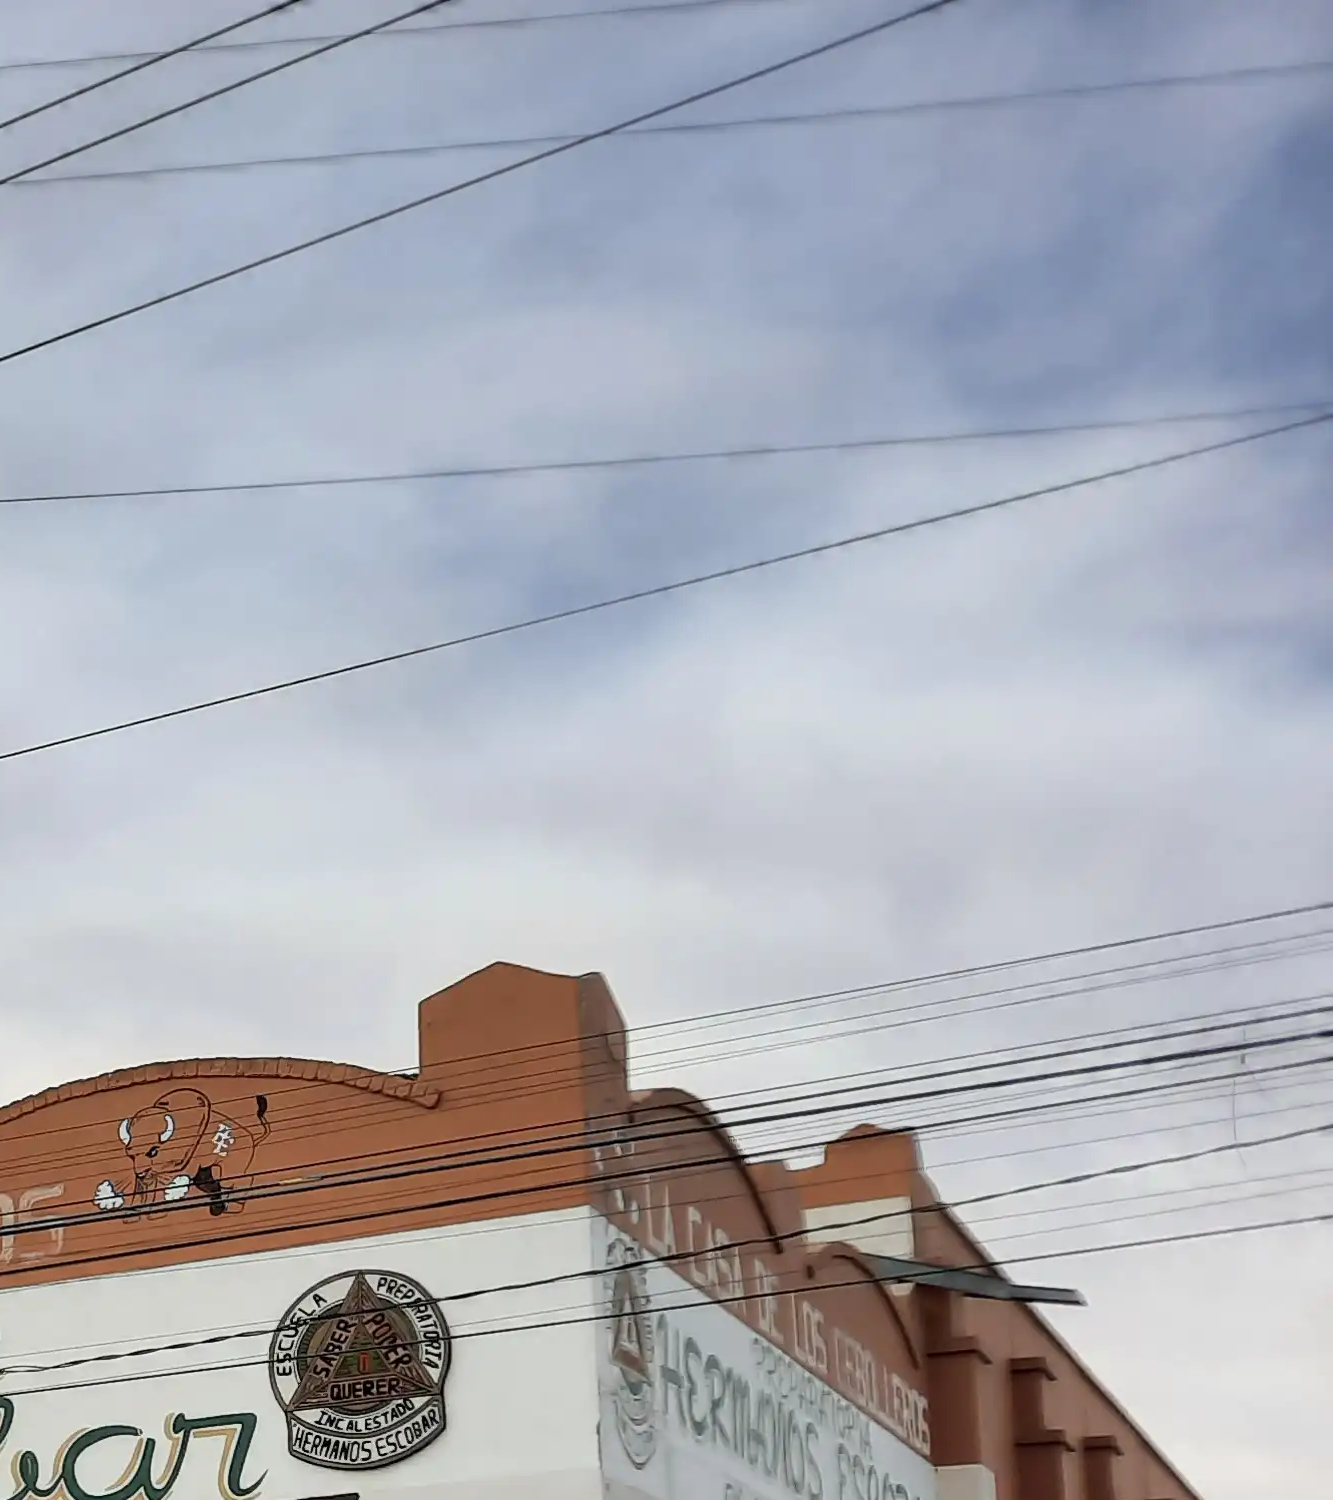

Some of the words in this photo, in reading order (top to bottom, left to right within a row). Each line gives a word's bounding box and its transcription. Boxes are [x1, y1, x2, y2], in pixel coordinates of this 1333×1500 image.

[312, 1317, 358, 1380] SABER
[363, 1312, 413, 1370] PODER
[329, 1376, 401, 1401] QUERER
